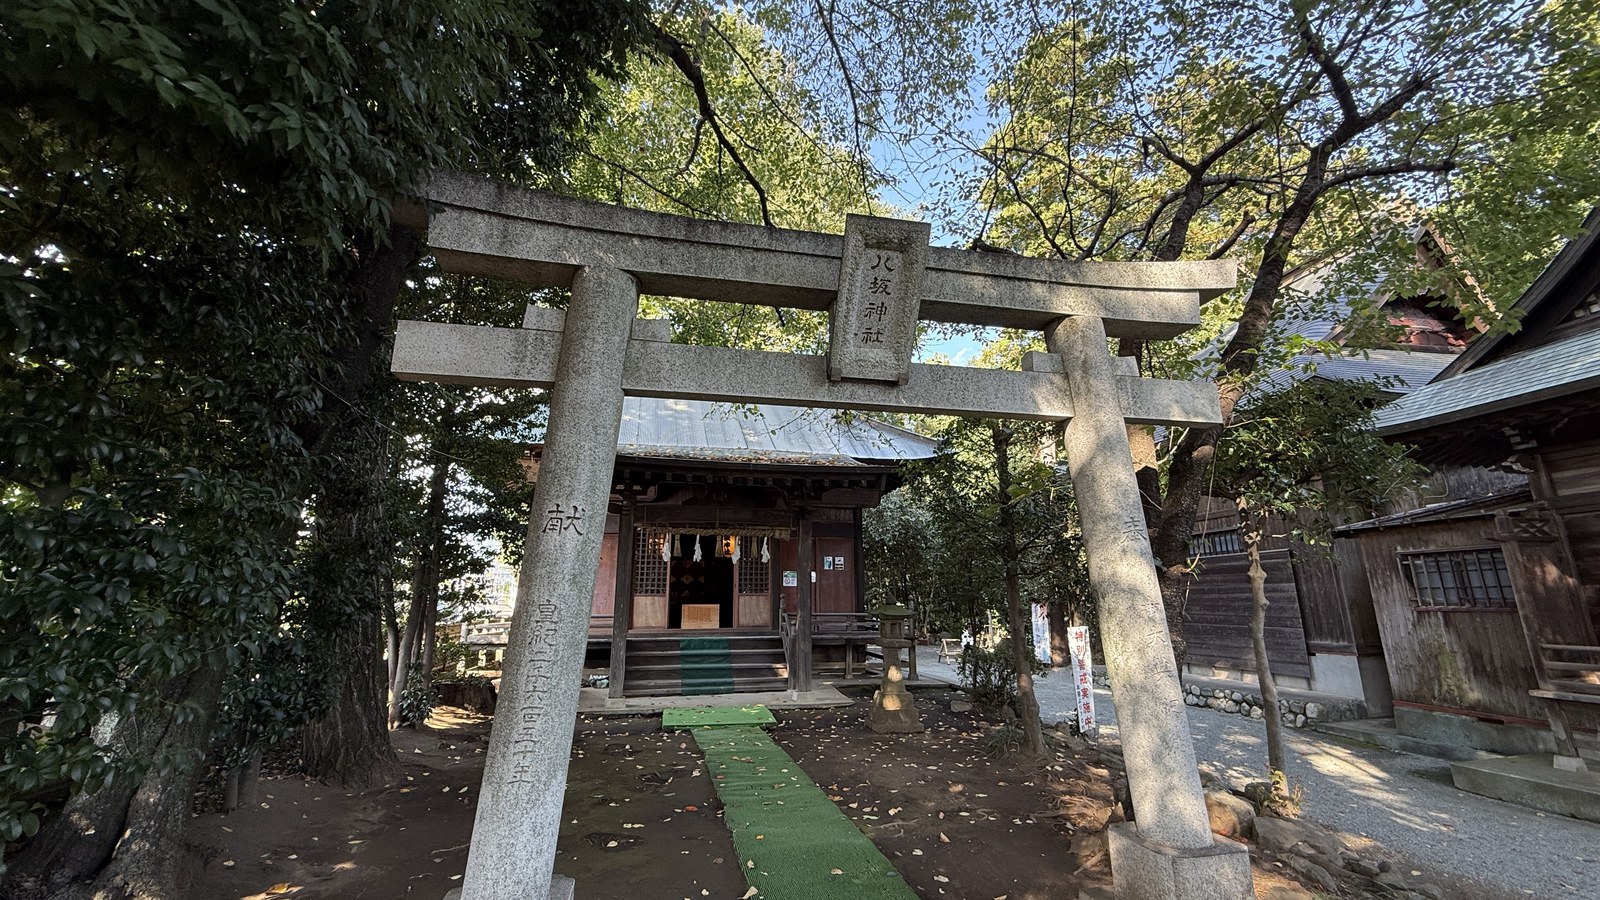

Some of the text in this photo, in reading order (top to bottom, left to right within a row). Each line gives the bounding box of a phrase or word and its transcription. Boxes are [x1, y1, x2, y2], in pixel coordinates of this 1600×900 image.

[861, 254, 895, 344] 八坂神社
[541, 503, 586, 536] 献
[1120, 516, 1147, 543] 奉
[507, 600, 558, 785] 皇紀二千六百五十年
